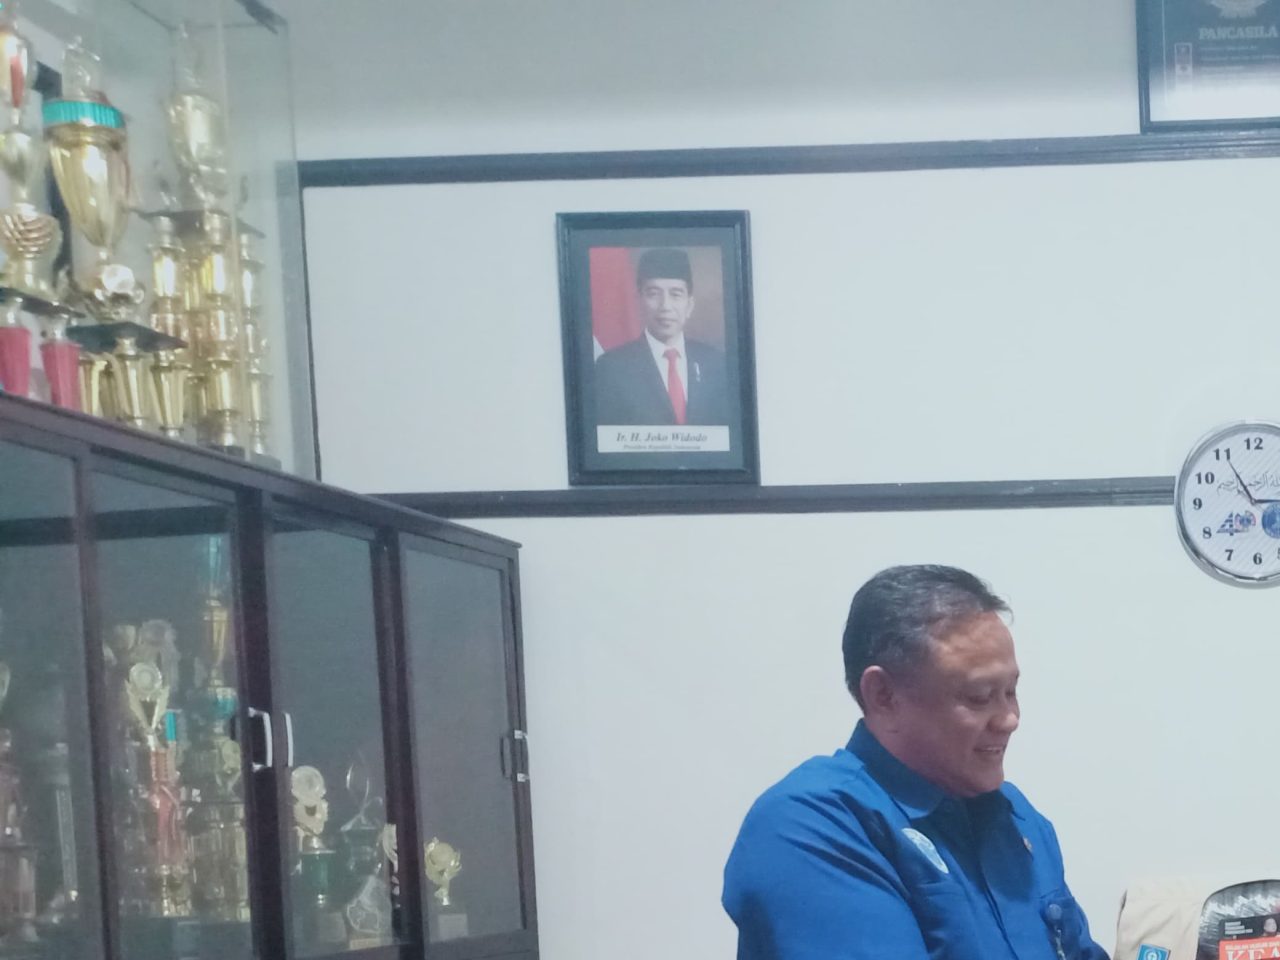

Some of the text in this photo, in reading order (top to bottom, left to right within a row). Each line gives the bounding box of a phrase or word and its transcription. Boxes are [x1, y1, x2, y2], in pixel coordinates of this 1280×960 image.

[1199, 25, 1279, 40] PANCASILA
[644, 432, 668, 442] Joko
[671, 432, 708, 442] Widodo
[1244, 437, 1263, 450] 12
[1214, 448, 1231, 461] 11
[1195, 471, 1215, 485] 10
[1193, 497, 1203, 510] 9
[1202, 526, 1212, 539] 8
[1225, 549, 1234, 561] 7
[1253, 552, 1263, 565] 6
